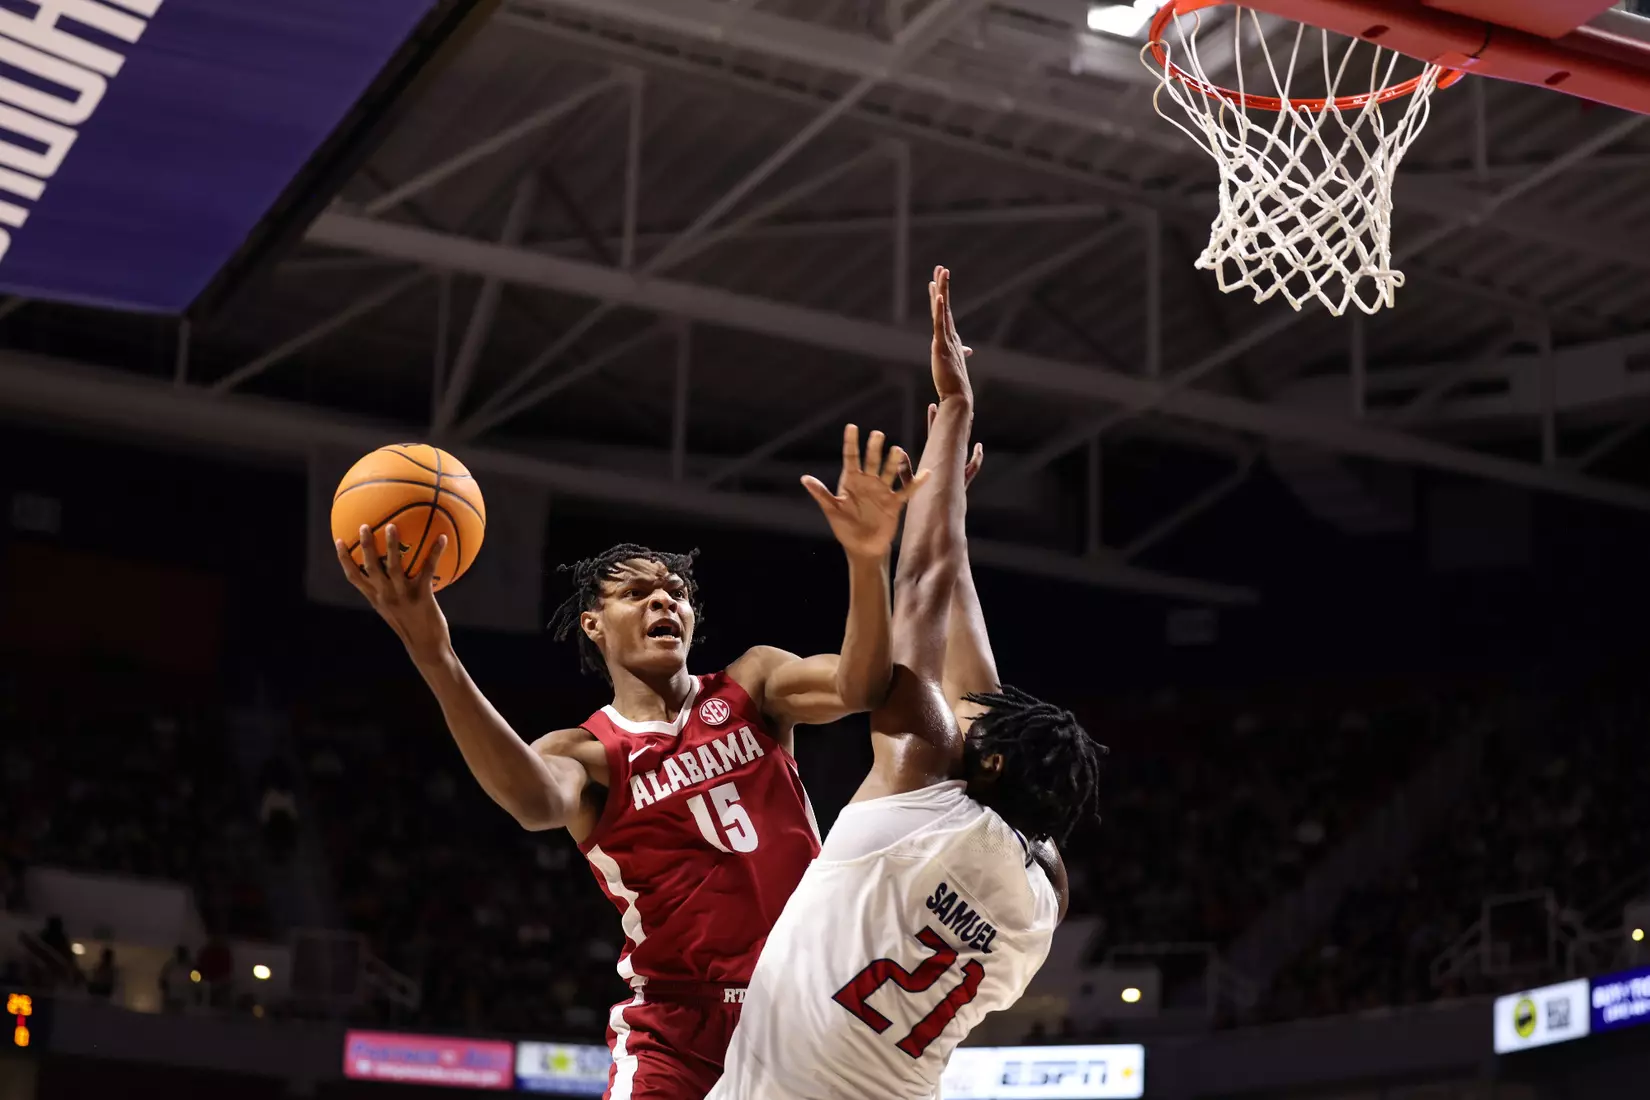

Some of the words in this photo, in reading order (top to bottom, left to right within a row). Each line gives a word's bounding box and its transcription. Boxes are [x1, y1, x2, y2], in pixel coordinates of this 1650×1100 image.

[701, 700, 728, 723] SEC
[629, 726, 764, 811] ALABAMA
[686, 781, 759, 853] 15
[925, 882, 997, 954] SAMUEL
[831, 925, 986, 1060] 21
